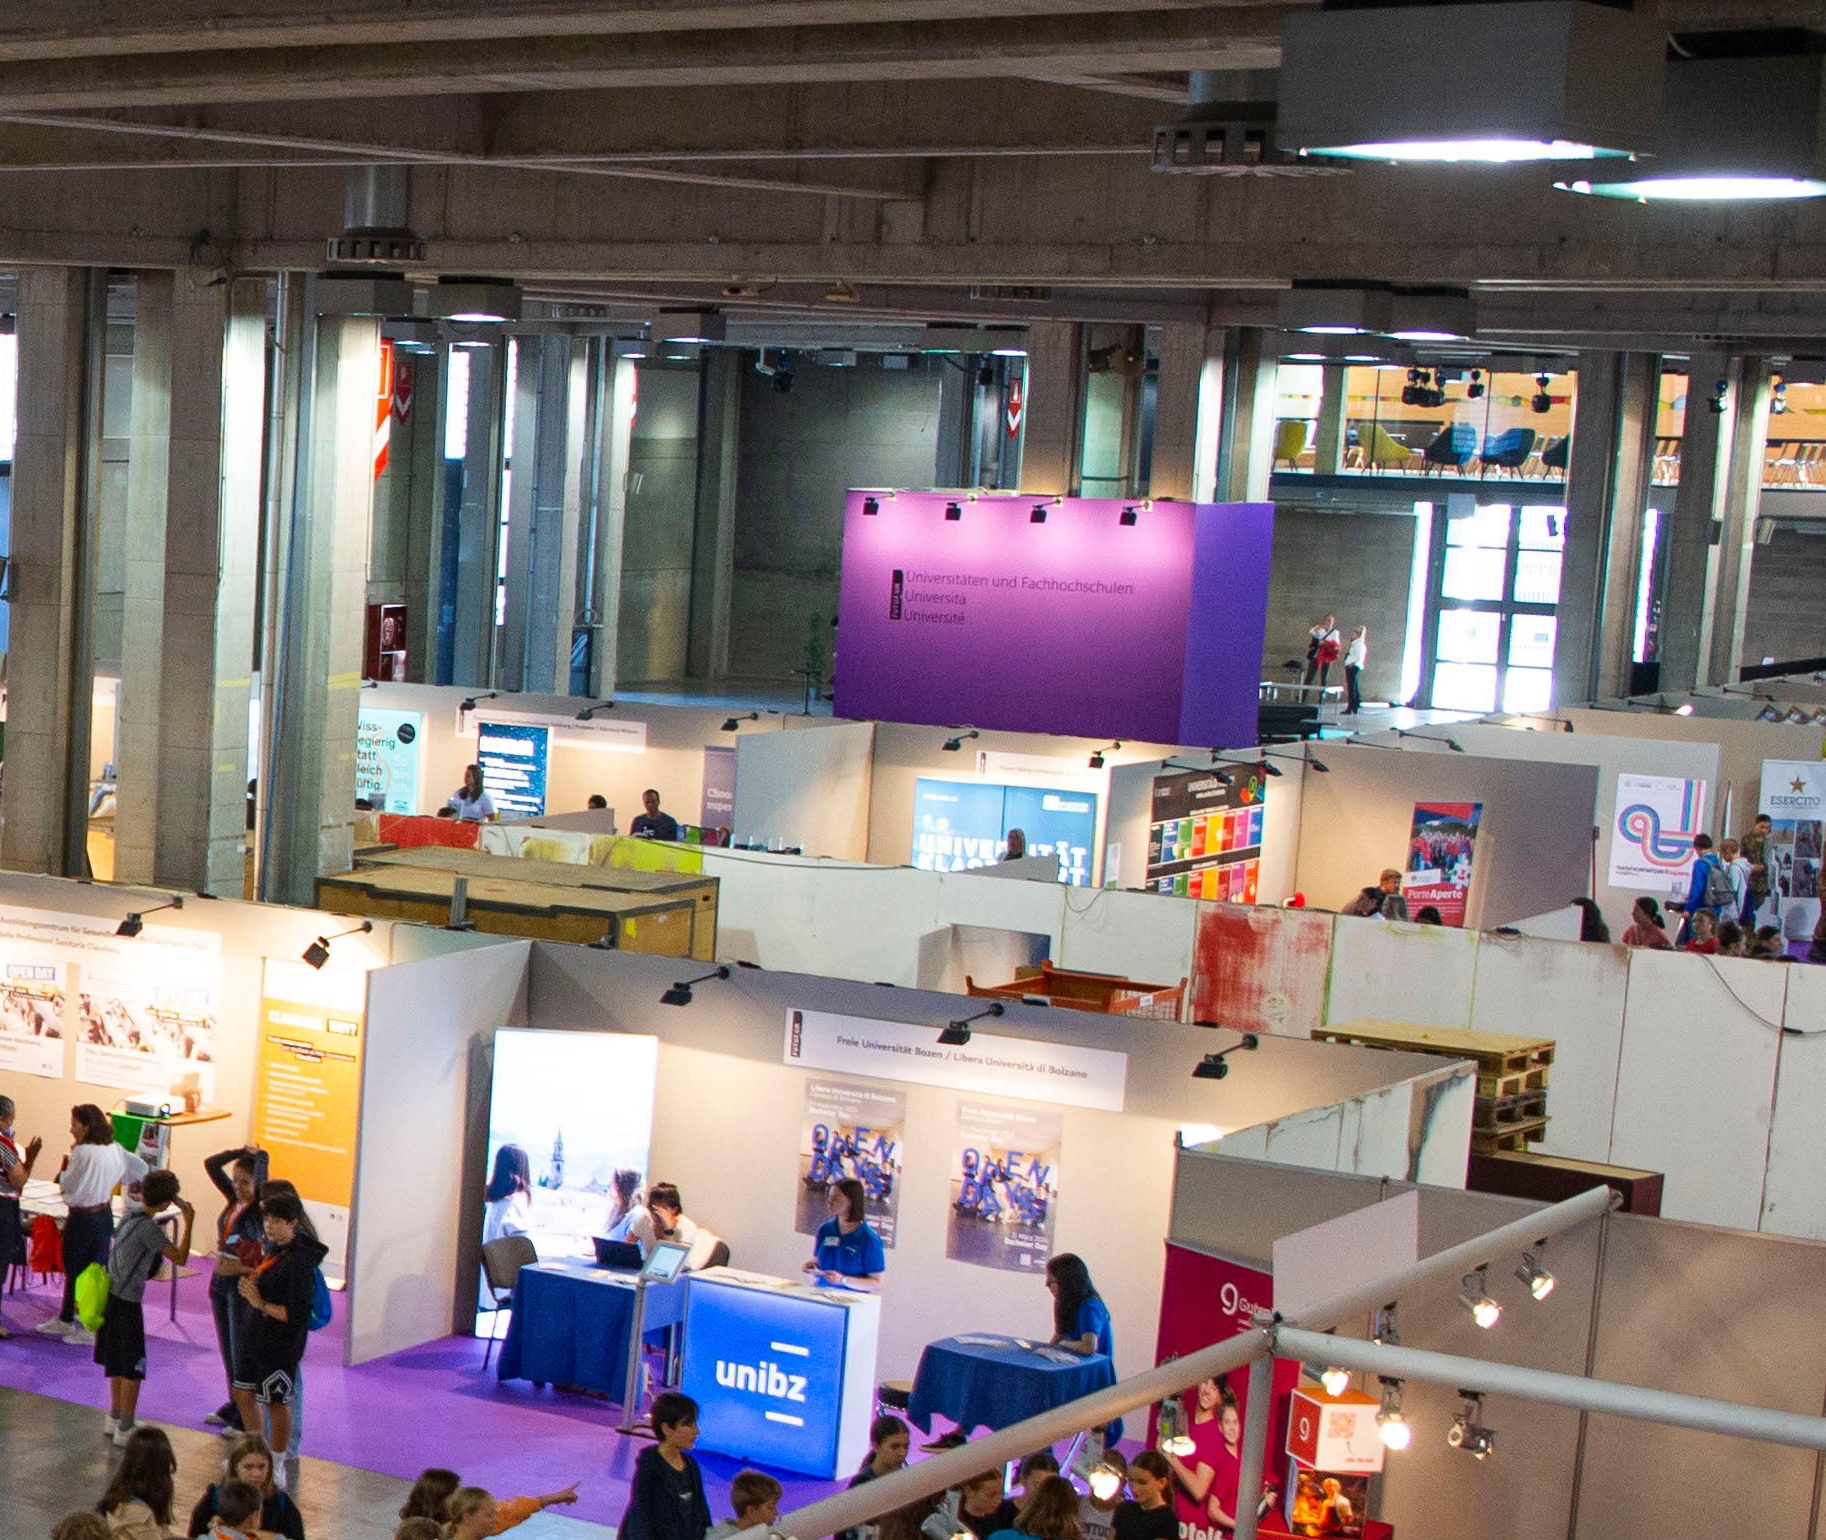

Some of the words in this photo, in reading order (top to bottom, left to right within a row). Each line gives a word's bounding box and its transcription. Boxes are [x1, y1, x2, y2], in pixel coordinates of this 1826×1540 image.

[904, 591, 967, 605] Università
[906, 570, 989, 587] Universitäten
[992, 576, 1017, 588] und
[1021, 576, 1134, 595] Fachhochschulen
[904, 609, 966, 625] Université
[1770, 795, 1821, 807] ESERCITO
[919, 833, 1086, 868] UNIVERITÄT
[836, 1035, 860, 1047] Freie
[861, 1039, 912, 1055] Universität
[914, 1047, 943, 1059] Bozen
[953, 1052, 983, 1064] Libera
[985, 1055, 1035, 1072] Università
[1036, 1062, 1046, 1071] di
[1048, 1065, 1088, 1079] Bolzano
[812, 1123, 895, 1163] OPEN
[962, 1148, 1051, 1187] OPEN
[715, 1357, 809, 1405] unibz
